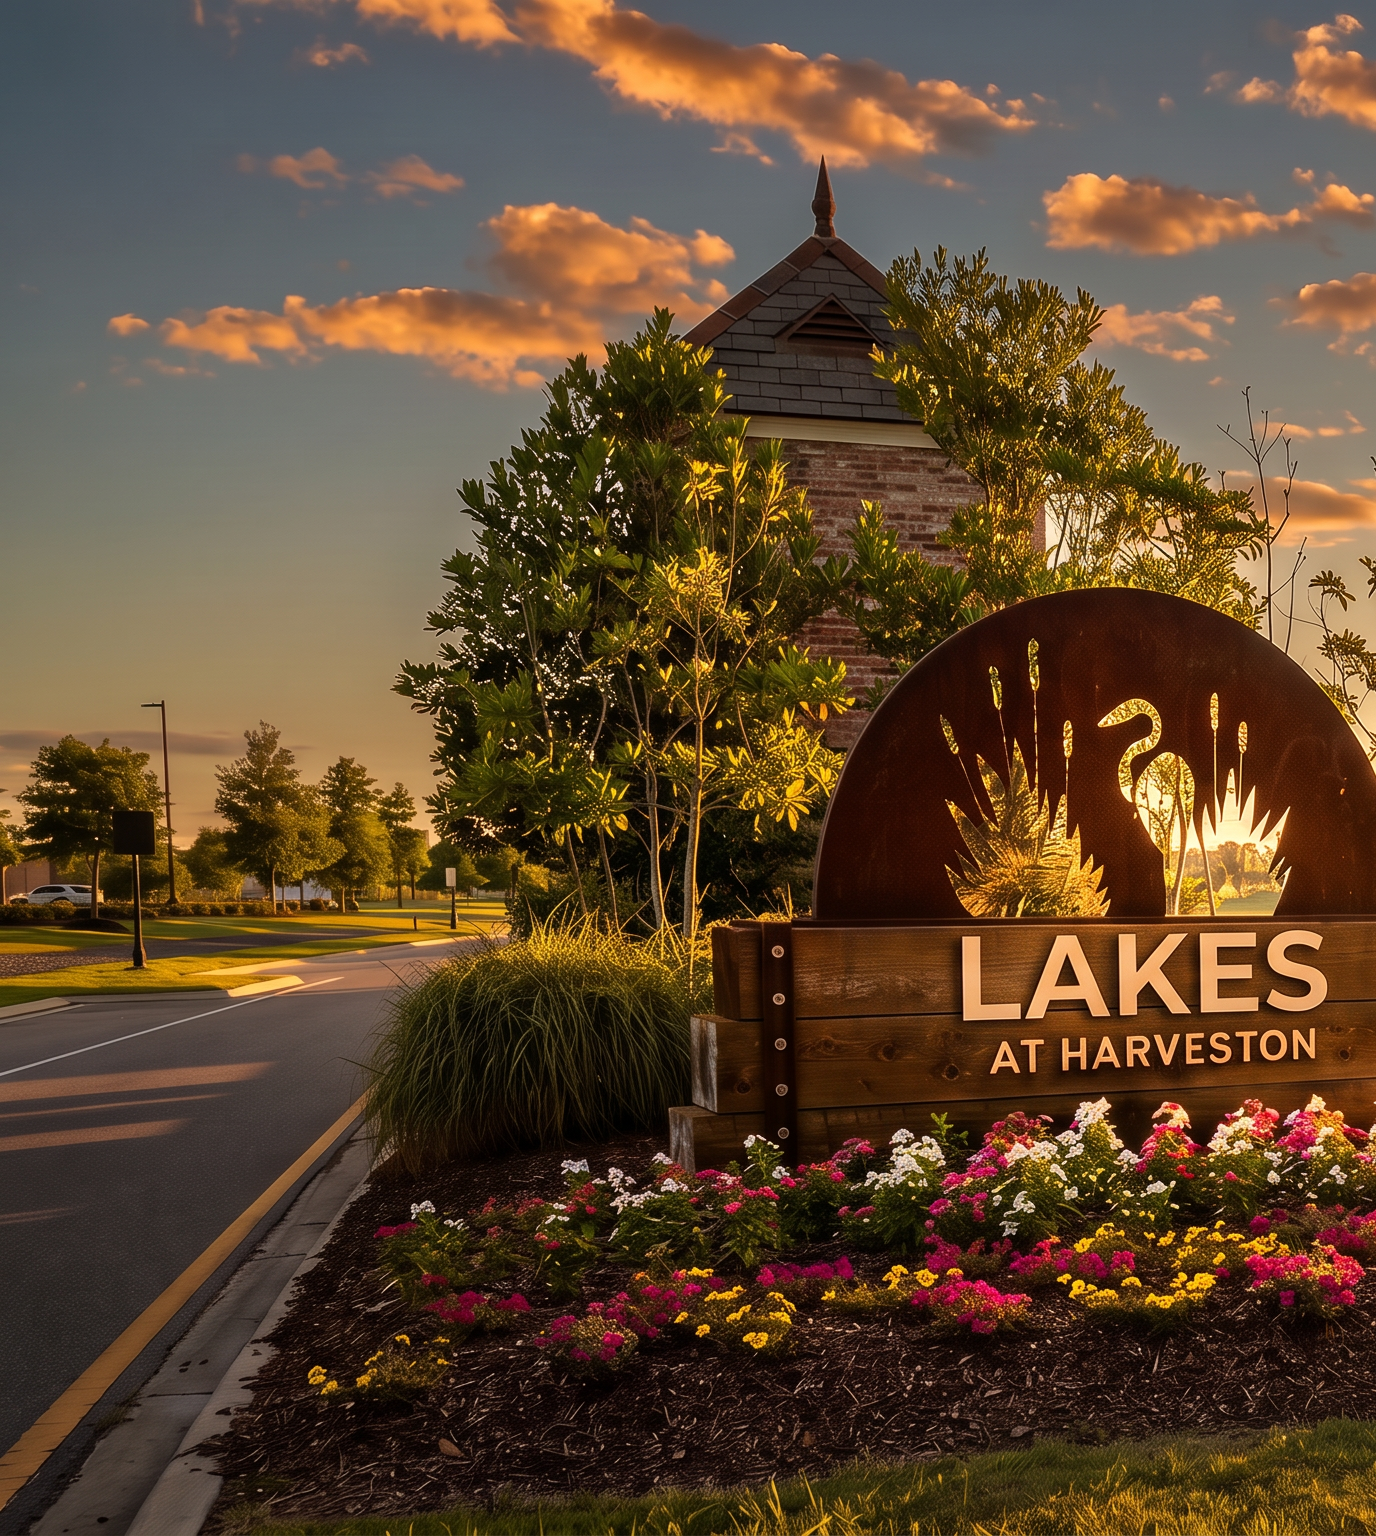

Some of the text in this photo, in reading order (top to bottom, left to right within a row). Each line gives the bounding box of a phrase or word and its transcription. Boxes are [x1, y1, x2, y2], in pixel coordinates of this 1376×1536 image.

[961, 930, 1328, 1021] LAKES
[989, 1028, 1317, 1075] AT HARVESTON
